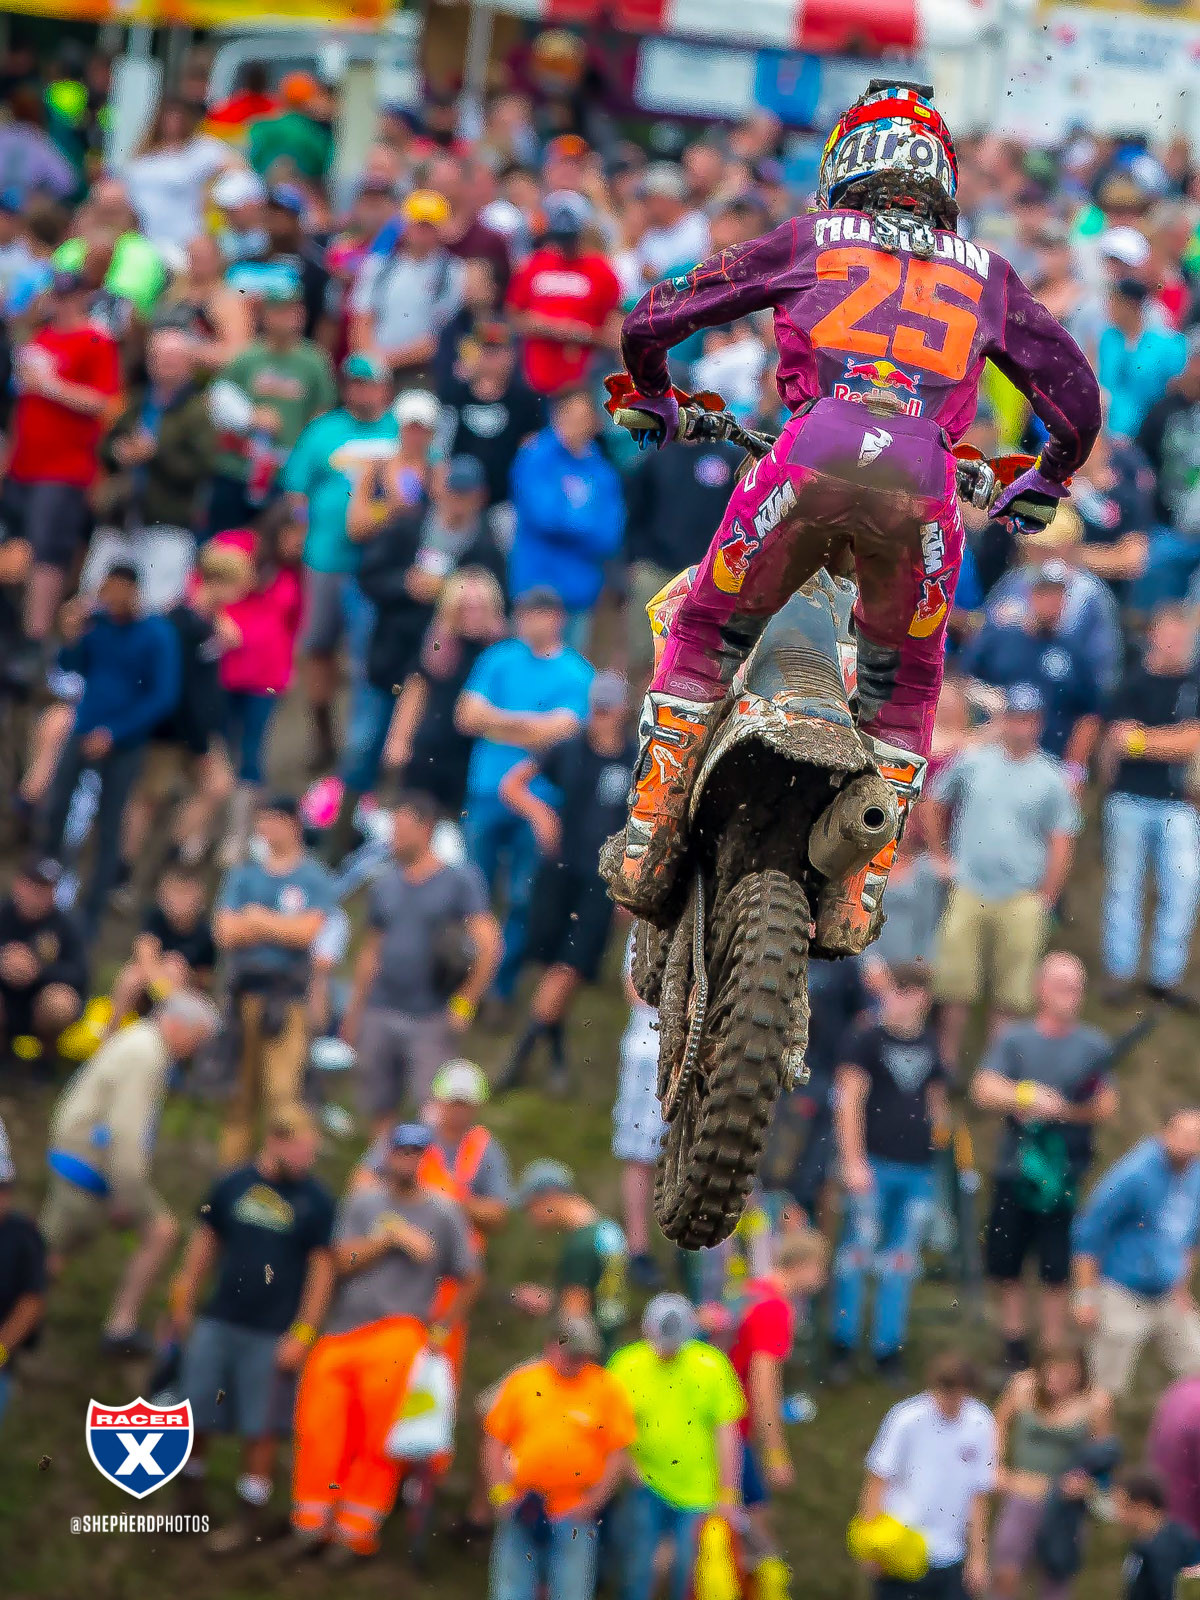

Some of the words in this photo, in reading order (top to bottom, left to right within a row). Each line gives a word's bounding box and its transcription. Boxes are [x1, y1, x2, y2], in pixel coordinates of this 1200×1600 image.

[815, 216, 990, 280] MUUIN
[810, 246, 983, 381] 25
[753, 480, 797, 538] KTM
[920, 522, 945, 574] KTM
